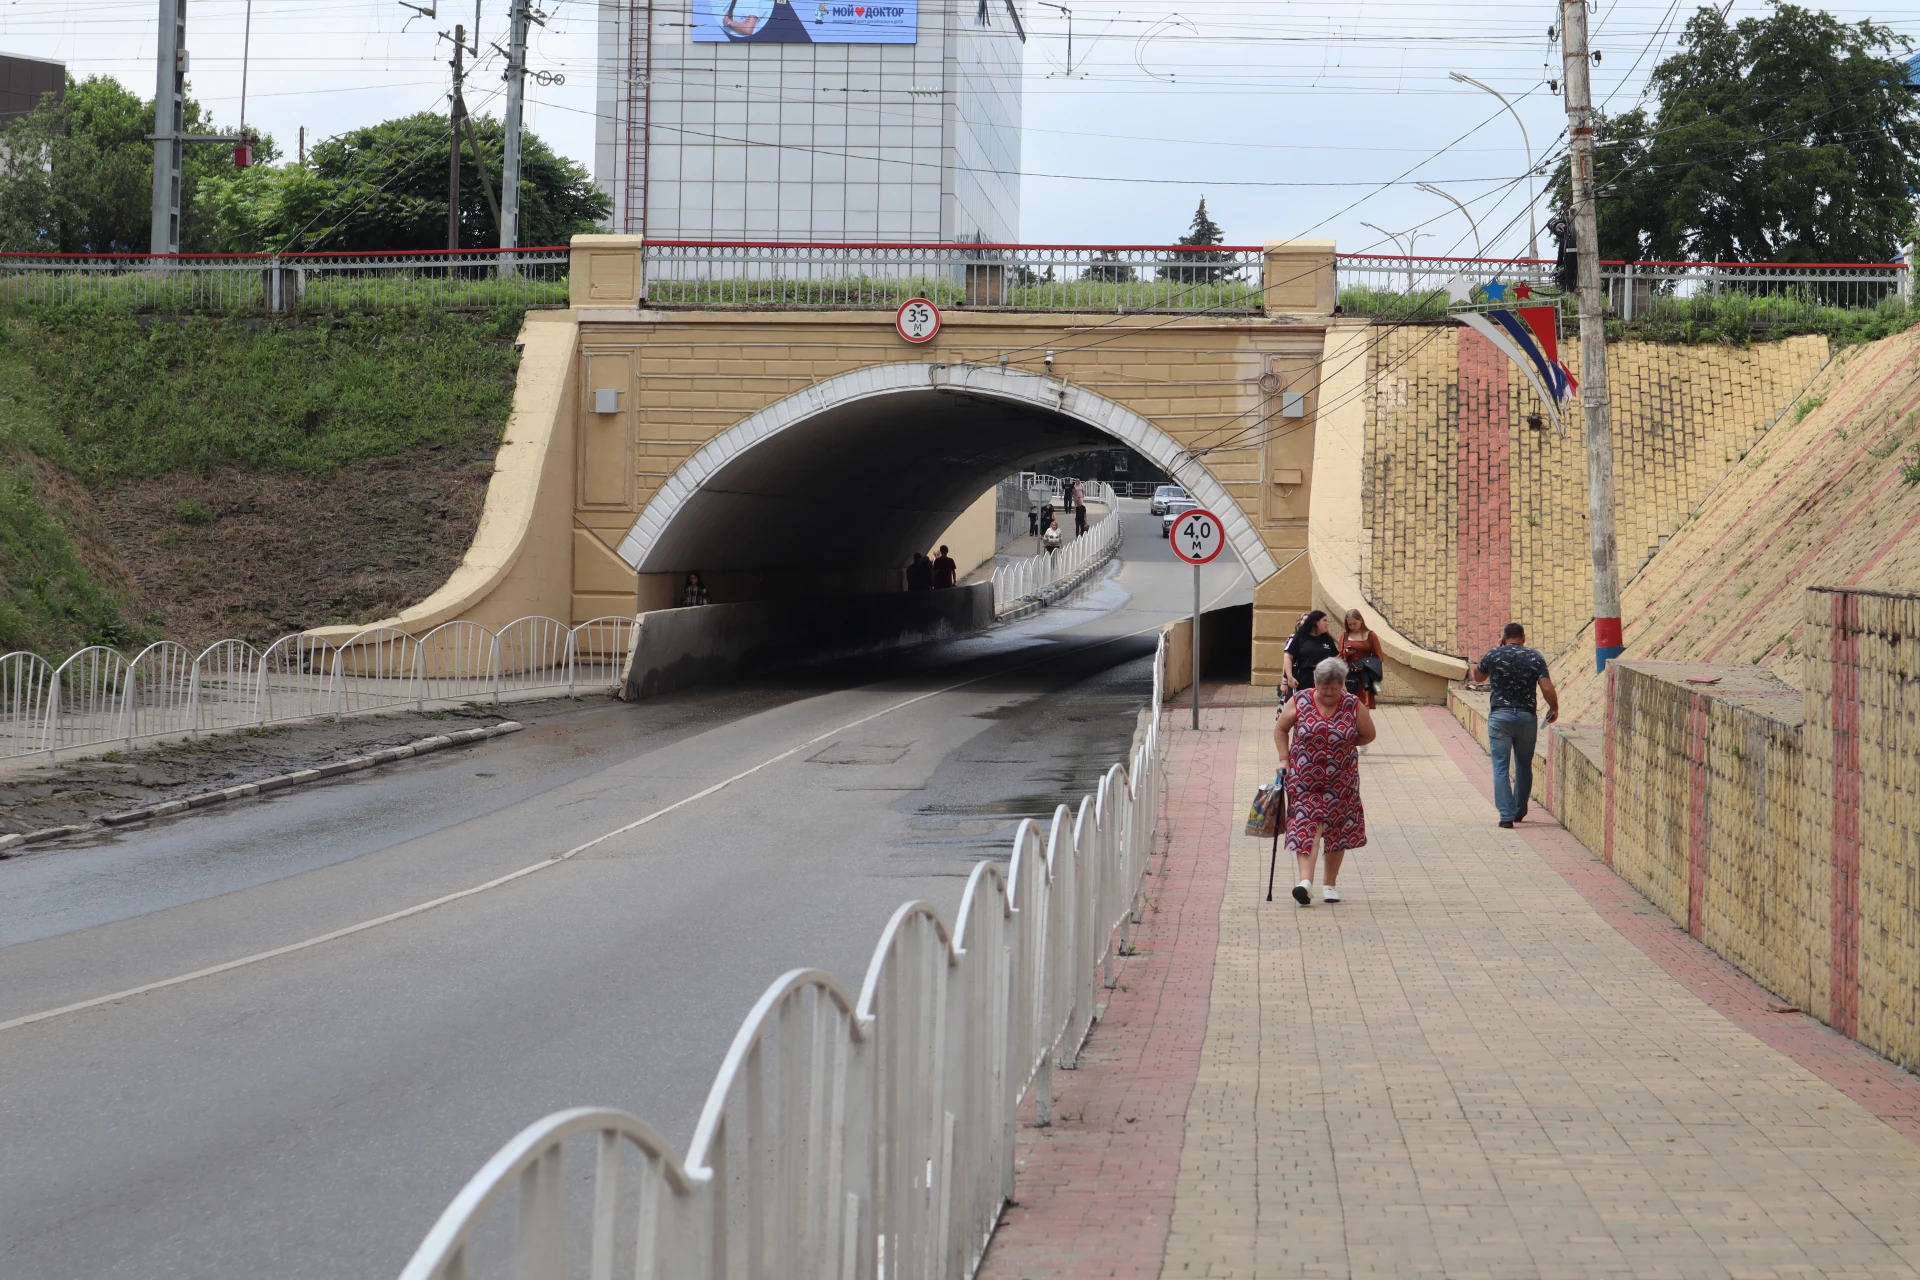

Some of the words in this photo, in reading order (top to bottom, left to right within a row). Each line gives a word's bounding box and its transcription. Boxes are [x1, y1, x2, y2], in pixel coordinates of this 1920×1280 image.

[832, 4, 854, 17] МОЙ
[865, 7, 904, 18] ДОКТОР
[1183, 522, 1211, 540] 4,0
